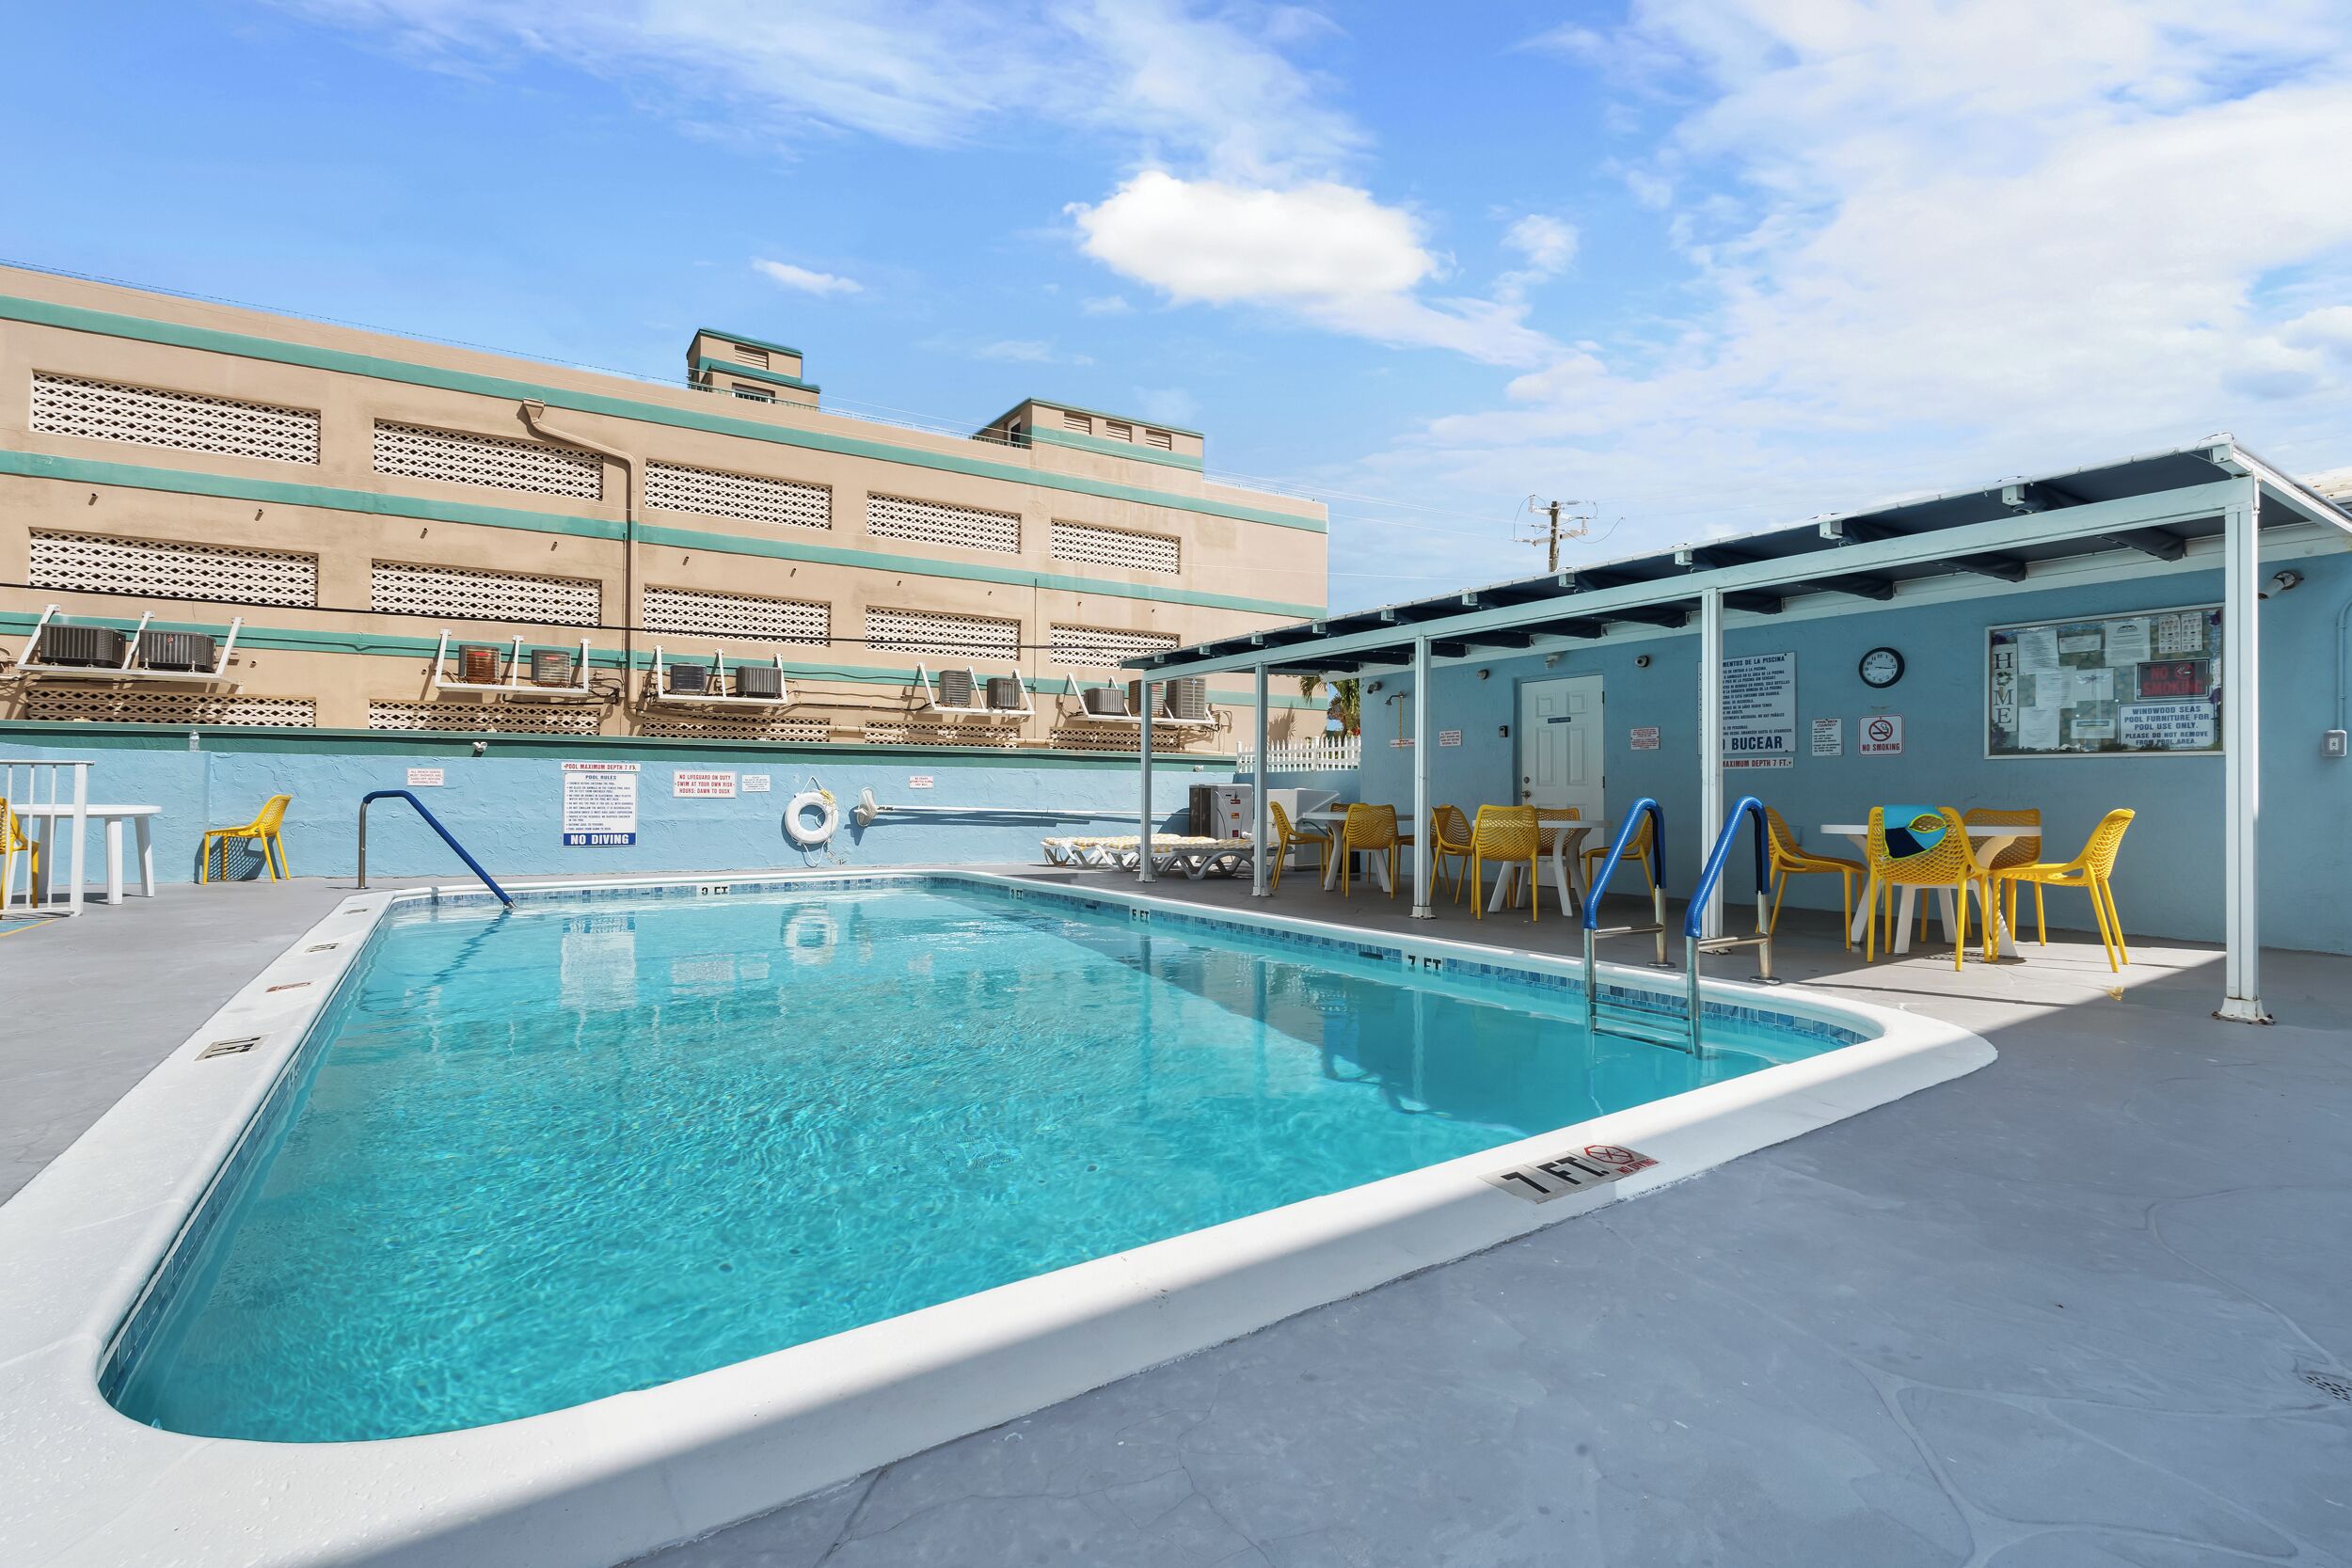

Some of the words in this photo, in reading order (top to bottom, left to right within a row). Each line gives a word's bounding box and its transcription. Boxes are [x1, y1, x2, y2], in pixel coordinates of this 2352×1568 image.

[1732, 736, 1782, 750] BUCEAR
[571, 835, 586, 844] NO
[591, 834, 629, 844] DIVING
[1408, 955, 1416, 965] 7
[1500, 1171, 1551, 1194] 7
[1537, 1156, 1610, 1185] FT.
